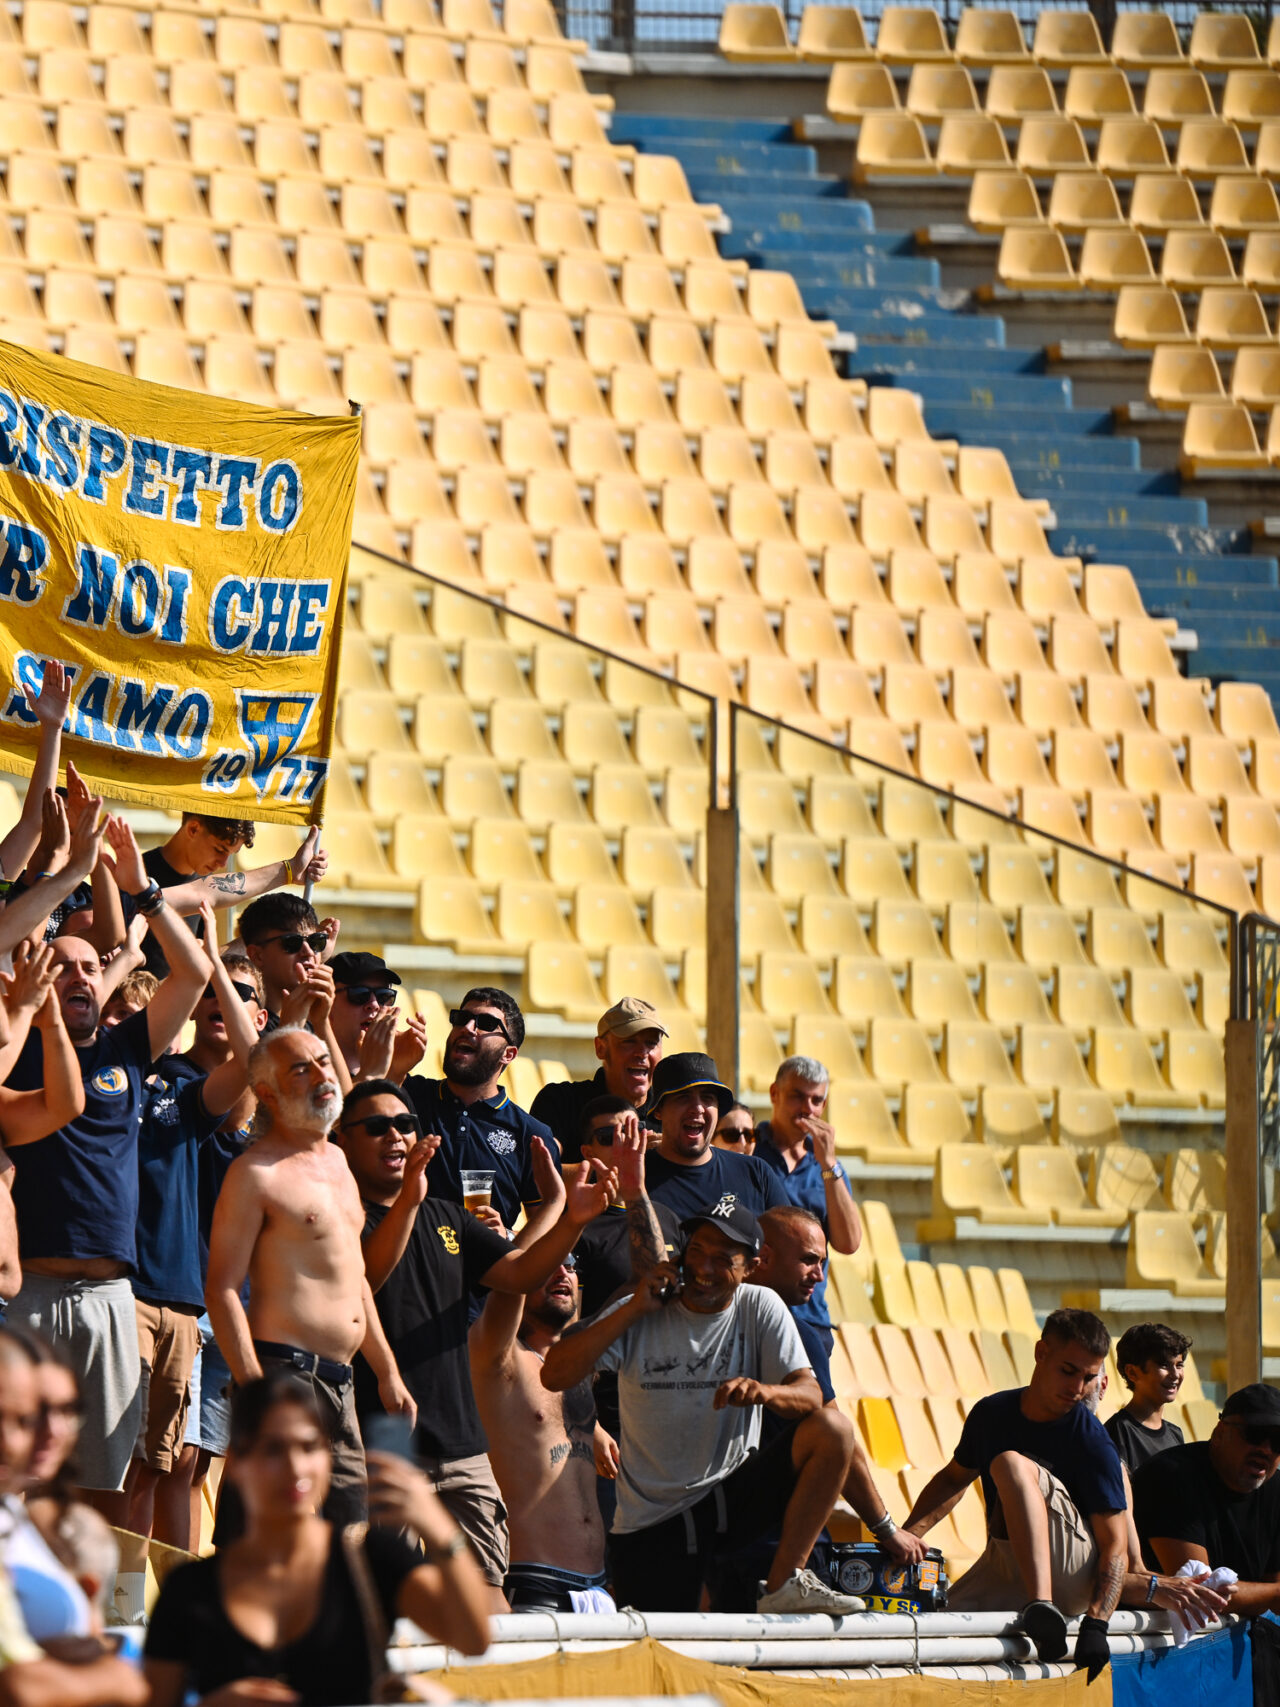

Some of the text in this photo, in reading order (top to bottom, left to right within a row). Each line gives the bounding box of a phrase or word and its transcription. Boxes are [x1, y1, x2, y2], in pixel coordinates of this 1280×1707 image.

[61, 543, 193, 647] NOI
[208, 575, 332, 656] CHE
[202, 748, 330, 804] 19 77
[865, 1596, 910, 1613] OYS
